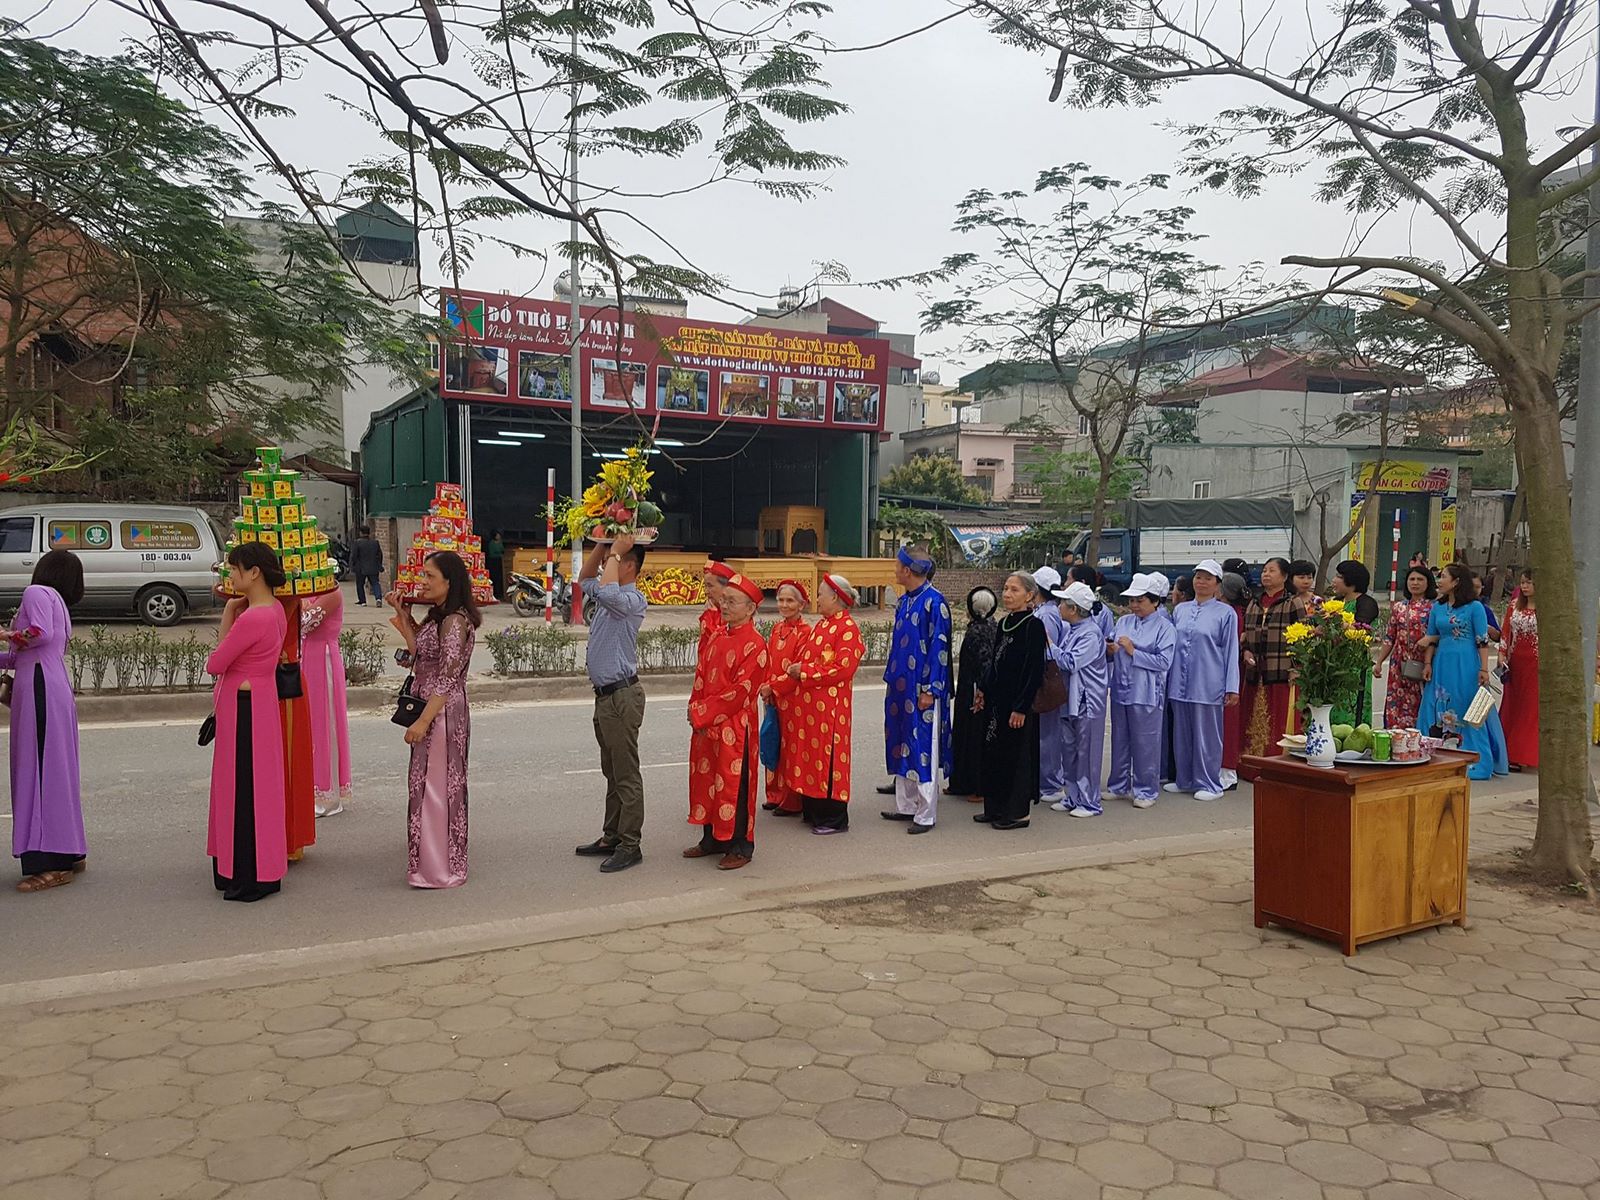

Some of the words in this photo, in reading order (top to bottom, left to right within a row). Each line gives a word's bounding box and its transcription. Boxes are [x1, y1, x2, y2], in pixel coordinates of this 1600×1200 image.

[516, 308, 551, 329] THỜ
[799, 365, 865, 380] 0913.870.861
[141, 553, 157, 561] 18D
[163, 553, 192, 561] 003.04
